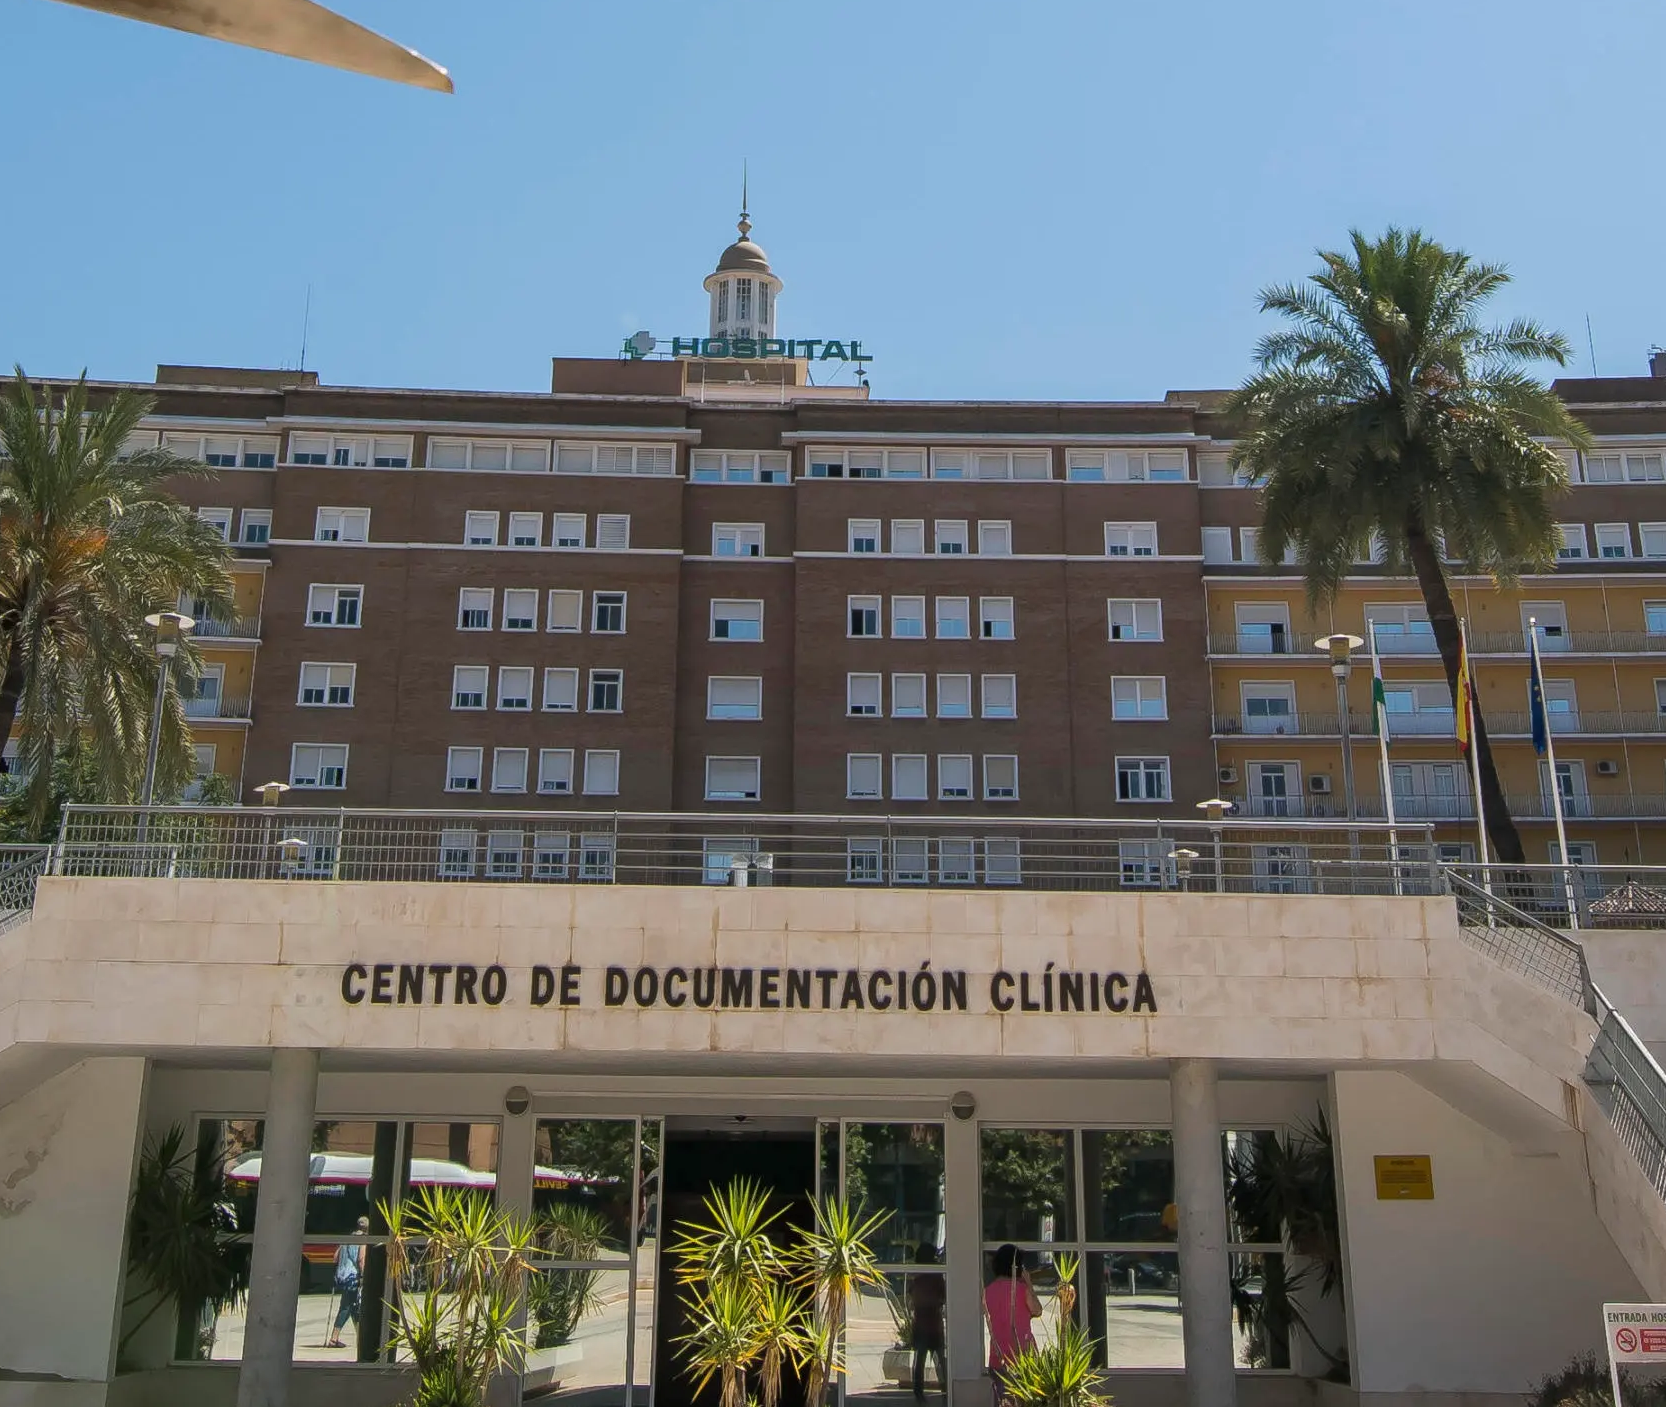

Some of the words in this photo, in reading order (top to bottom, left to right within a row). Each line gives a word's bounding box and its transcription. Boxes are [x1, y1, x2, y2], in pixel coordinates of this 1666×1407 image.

[672, 337, 873, 361] HOSPITAL
[341, 964, 507, 1006] CENTRO
[530, 965, 583, 1008] DE
[605, 960, 967, 1011] DOCUMENTACIÓN
[990, 961, 1158, 1013] CLÍNICA
[1607, 1312, 1648, 1323] ENTRADA
